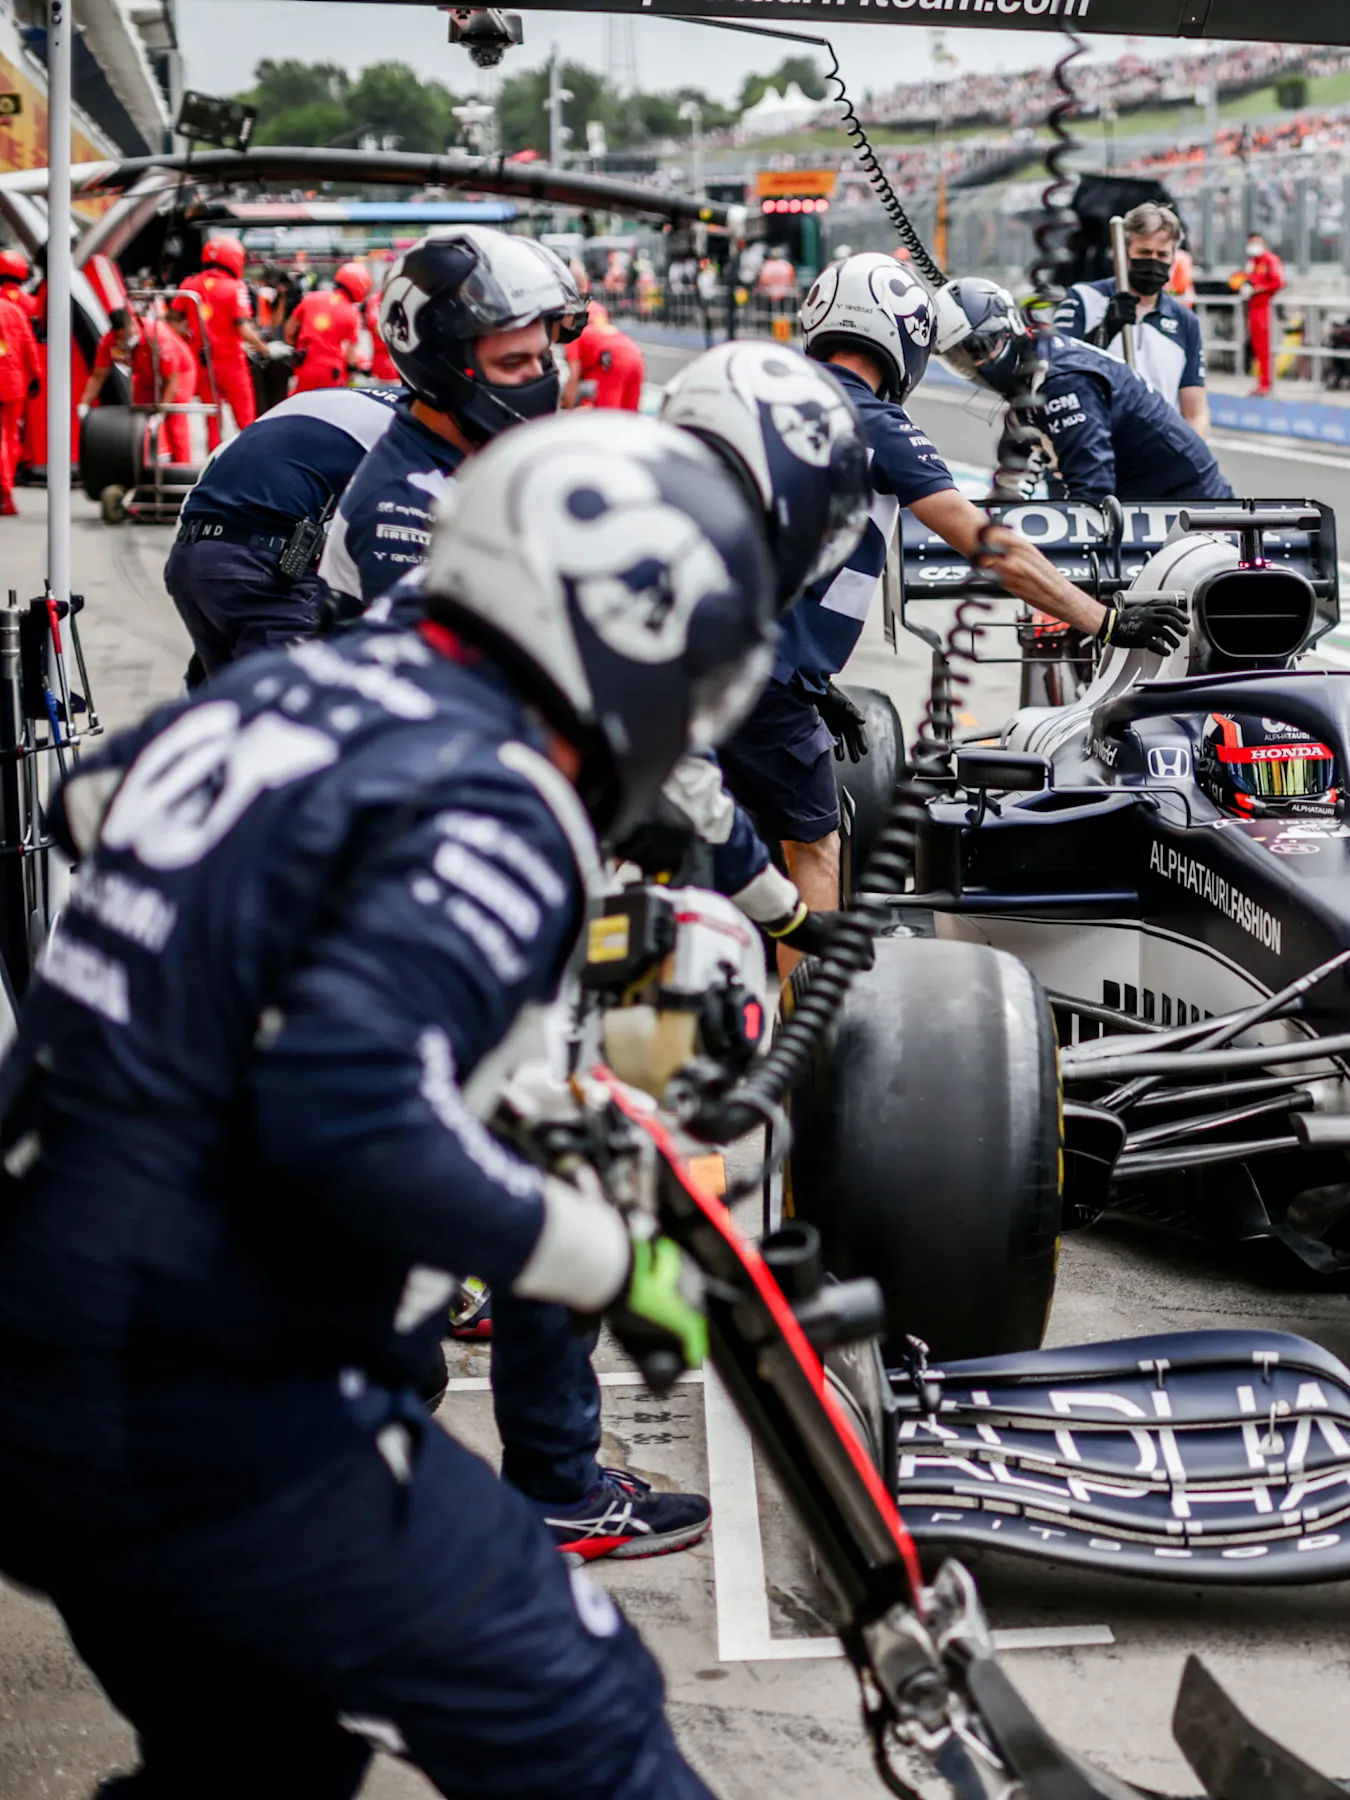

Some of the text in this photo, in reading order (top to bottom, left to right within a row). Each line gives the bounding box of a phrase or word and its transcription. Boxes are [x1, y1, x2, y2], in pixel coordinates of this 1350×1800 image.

[1250, 746, 1325, 760] HONDA
[1291, 803, 1335, 816] ALPHATAURI
[1150, 839, 1282, 956] ALPHATAURI.FASHION
